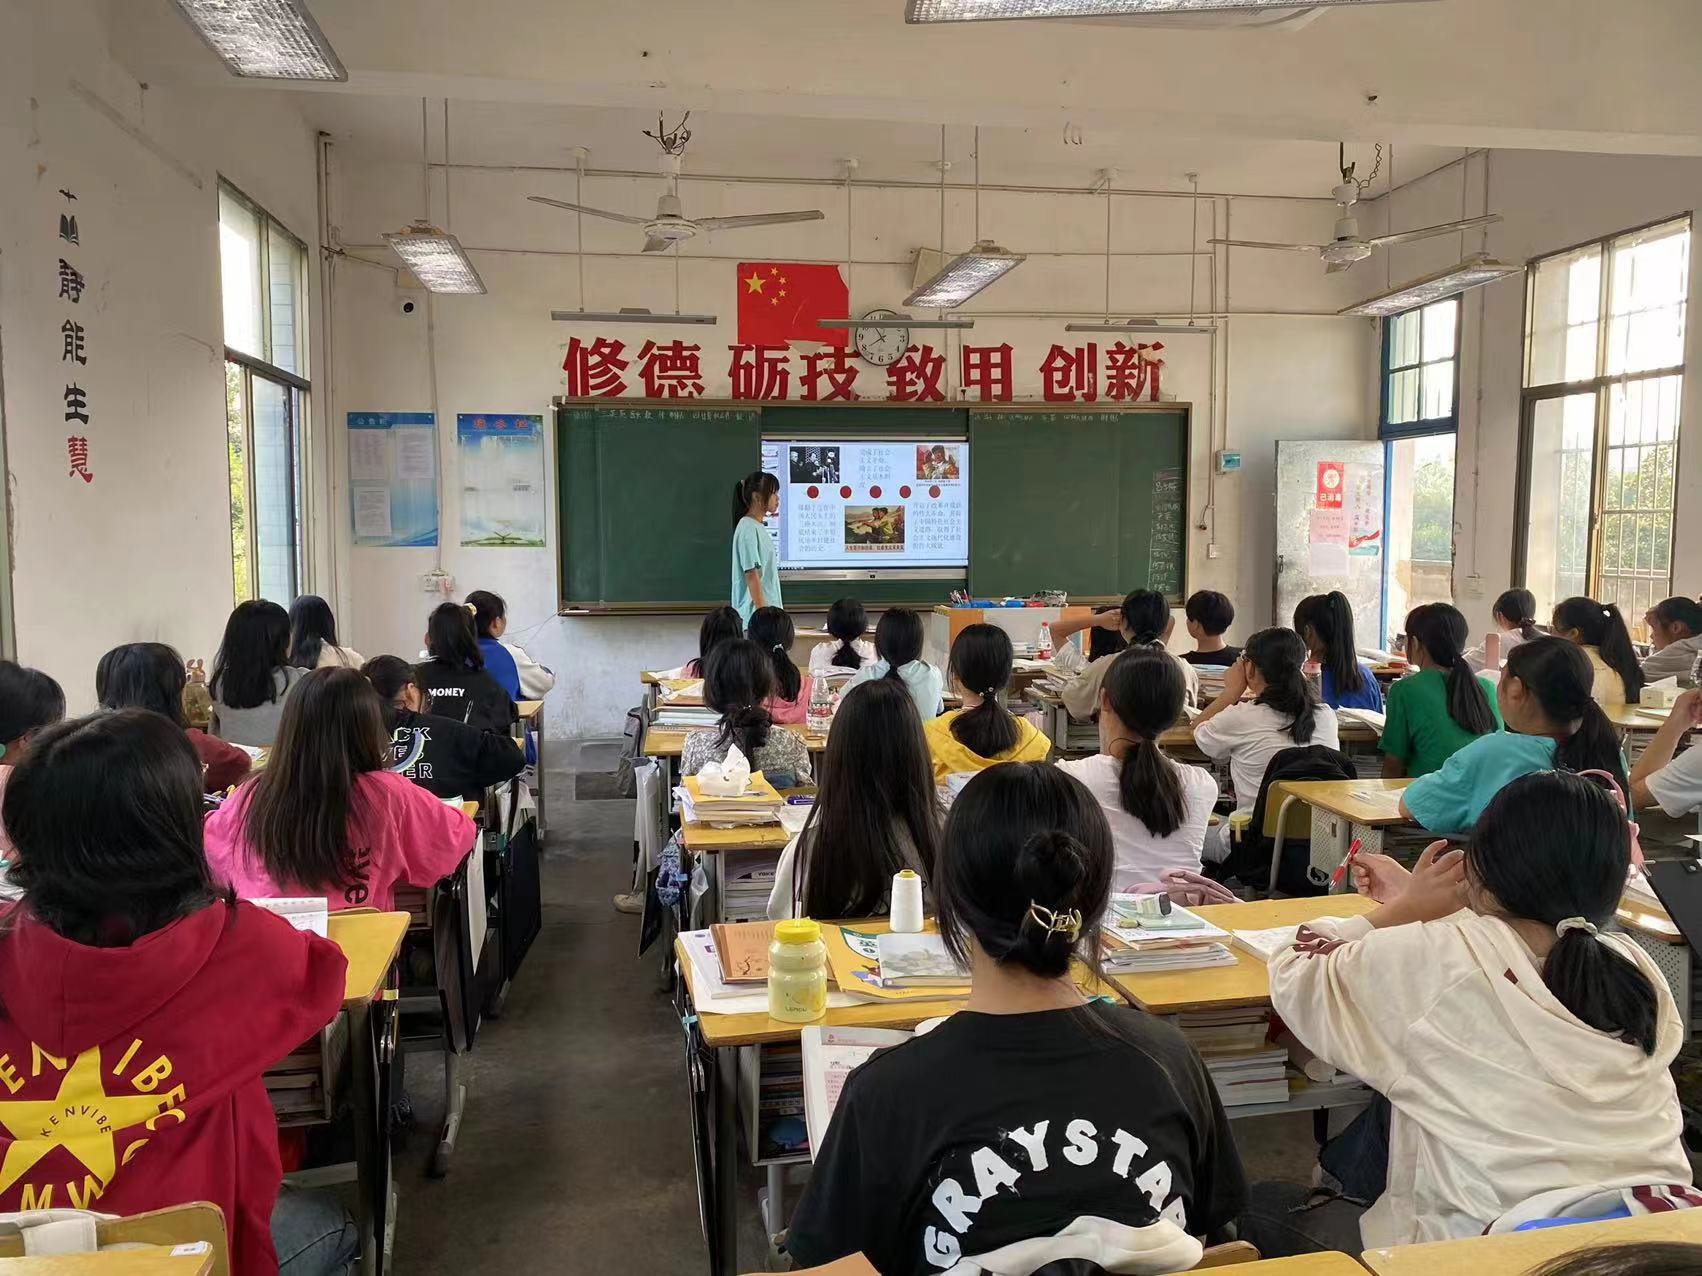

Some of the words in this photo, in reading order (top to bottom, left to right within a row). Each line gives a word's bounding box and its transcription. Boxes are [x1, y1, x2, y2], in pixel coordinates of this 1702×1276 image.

[562, 337, 705, 398] 修德
[728, 344, 861, 400] 砺技
[886, 342, 1014, 401] 致用
[1039, 341, 1166, 402] 创新
[428, 688, 465, 697] MONEY
[40, 1105, 112, 1138] KENVIBE
